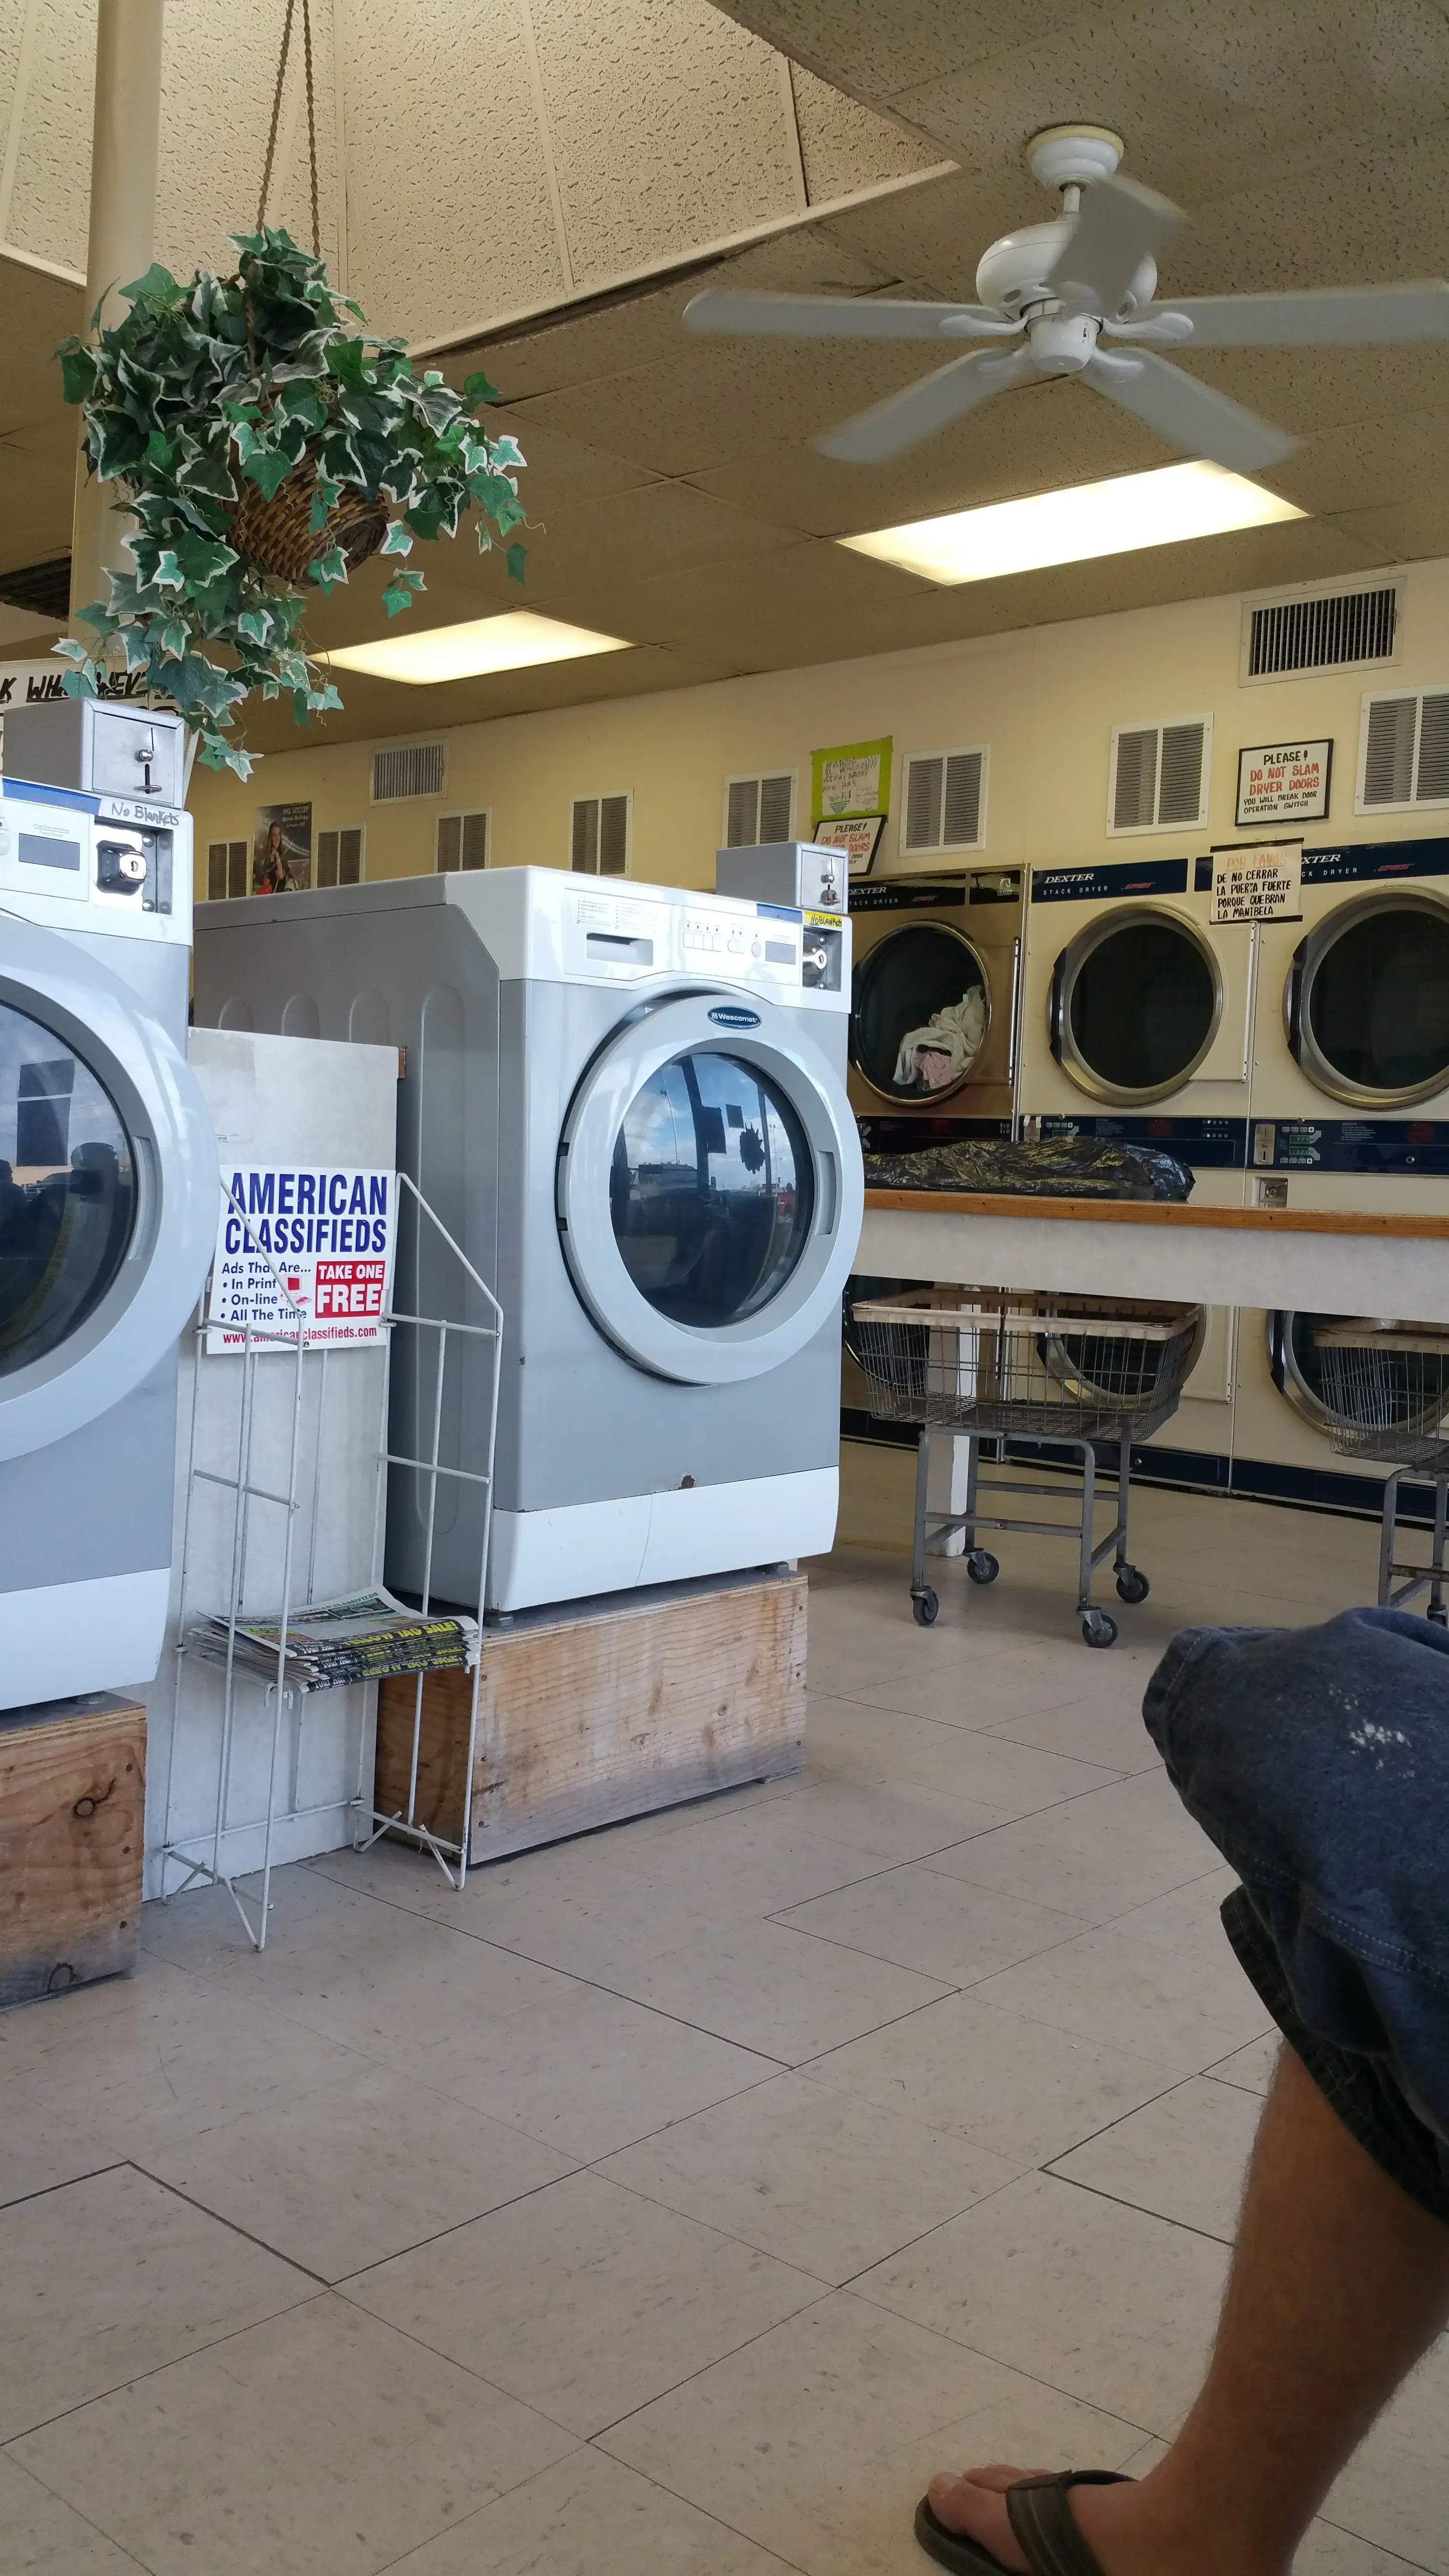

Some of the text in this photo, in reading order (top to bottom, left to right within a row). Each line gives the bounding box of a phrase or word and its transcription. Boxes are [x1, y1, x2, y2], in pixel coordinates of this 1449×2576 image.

[1250, 763, 1320, 782] DO NOT SLAM
[1249, 776, 1320, 796] DRYER DOORS
[1278, 793, 1299, 801] BREAK
[112, 802, 130, 817] No
[1244, 800, 1308, 814] OPERATION SWITCH
[821, 833, 870, 845] DO NOT SLAM
[1044, 873, 1094, 884] DEXTER
[1217, 869, 1278, 884] DE NO CERRAR
[1323, 868, 1357, 876] DRYER
[848, 887, 886, 896] DEXTER
[1217, 880, 1292, 896] LA PUERTA FUERTE
[1218, 893, 1286, 908] PORQUE QUEBRAN
[1218, 906, 1273, 919] LA MANIBELA
[718, 1013, 757, 1022] Wascomat
[227, 1173, 387, 1215] AMERICAN
[225, 1218, 387, 1255] CLASSIFIEDS
[222, 1261, 311, 1274] Ads Tha Are...
[319, 1264, 384, 1280] TAKE ONE
[232, 1278, 277, 1289] In Print
[231, 1293, 278, 1305] On-line
[317, 1283, 382, 1313] FREE
[230, 1309, 247, 1321] All
[252, 1309, 274, 1320] The
[394, 1627, 422, 1638] TAG
[422, 1621, 459, 1634] SALE!
